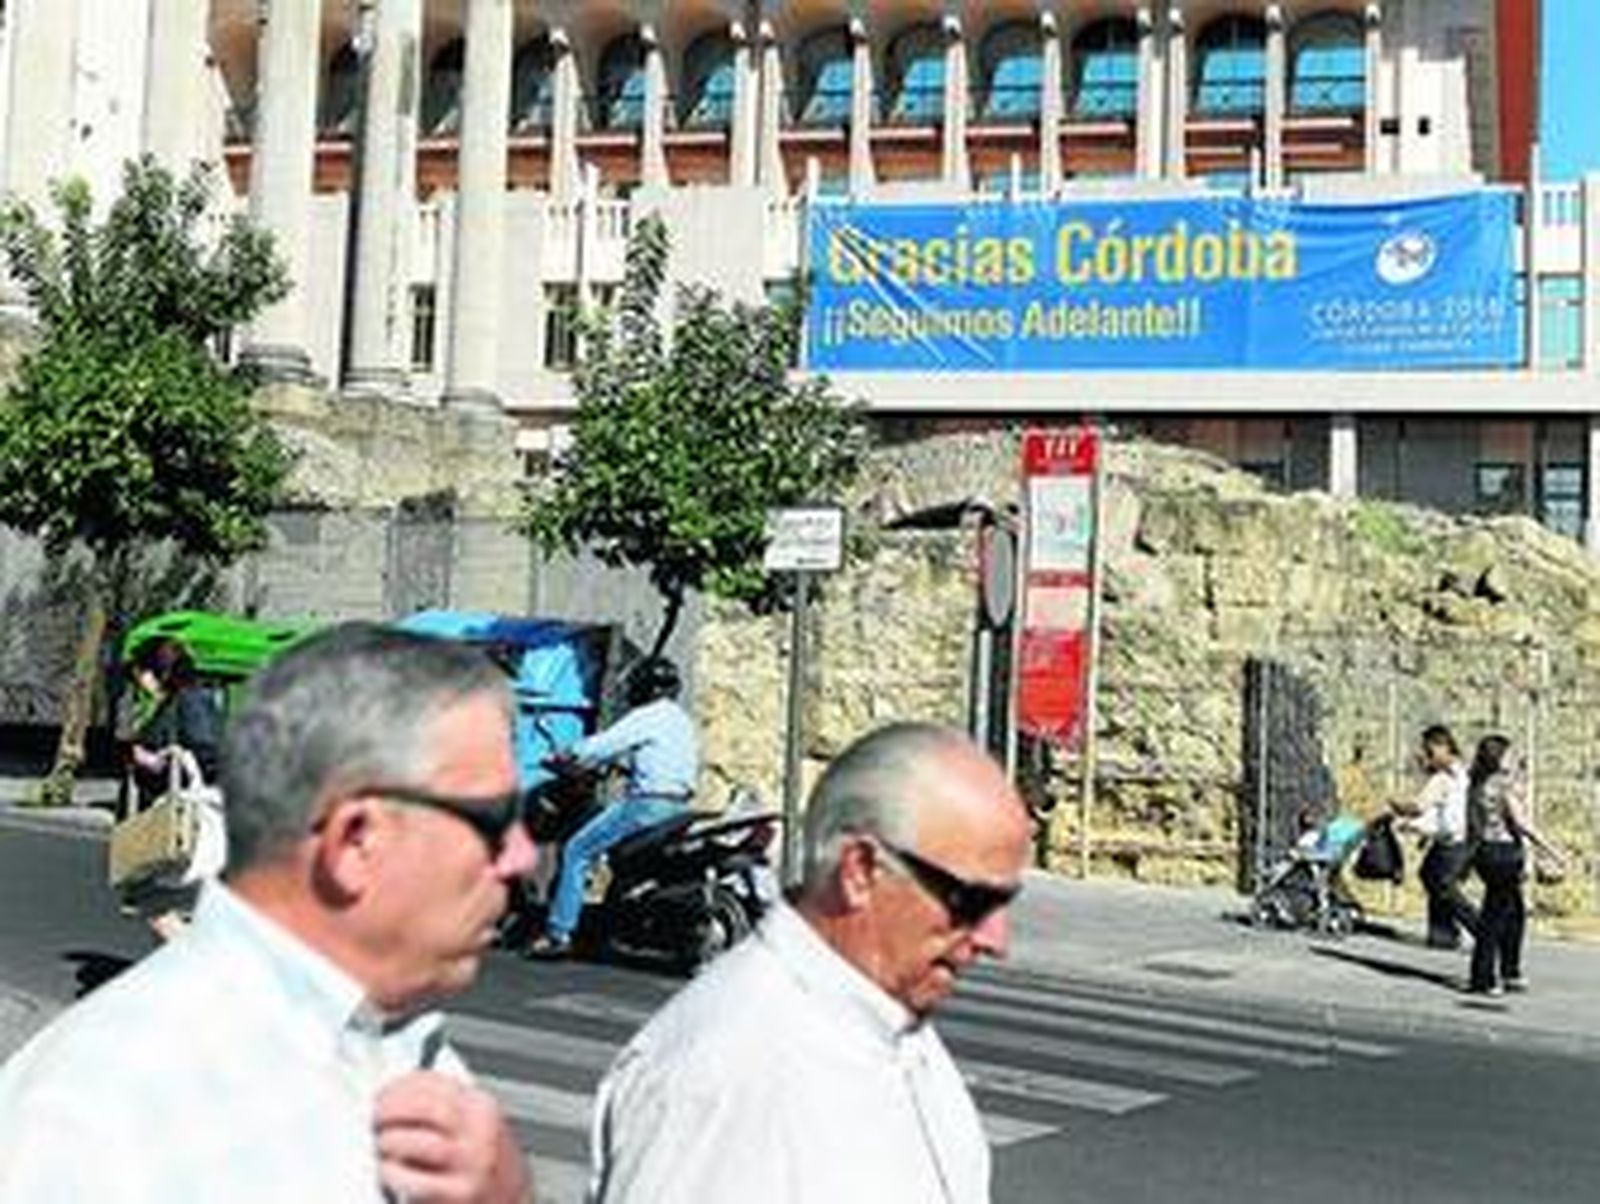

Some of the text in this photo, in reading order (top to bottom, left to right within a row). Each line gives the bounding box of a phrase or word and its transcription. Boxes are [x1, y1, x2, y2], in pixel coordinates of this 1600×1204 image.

[828, 217, 1297, 286] Gracias Córdoba
[1021, 297, 1201, 340] Adelante!!
